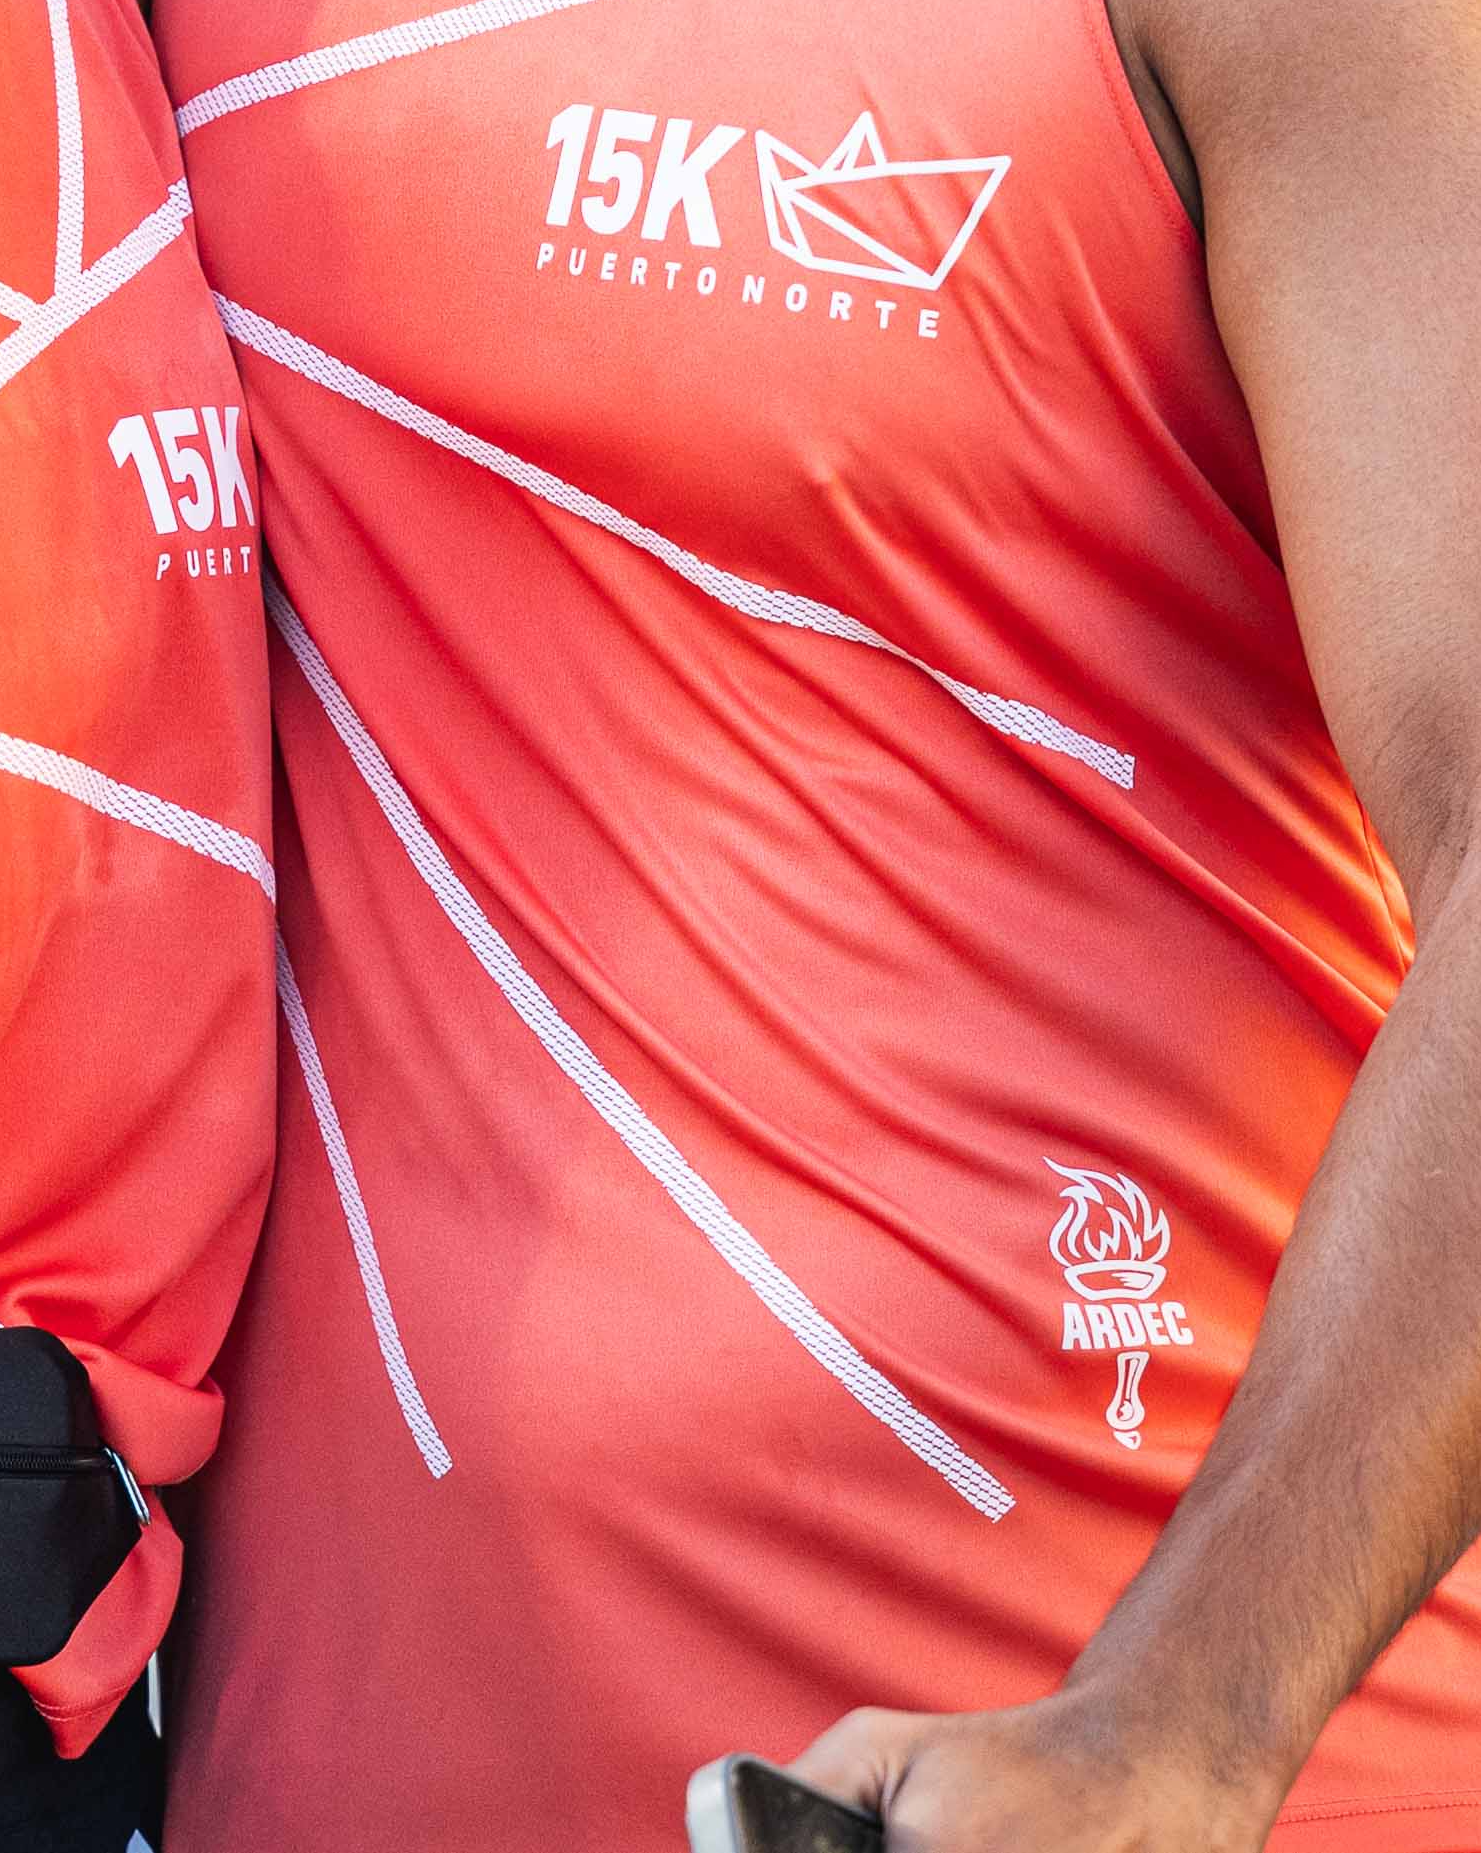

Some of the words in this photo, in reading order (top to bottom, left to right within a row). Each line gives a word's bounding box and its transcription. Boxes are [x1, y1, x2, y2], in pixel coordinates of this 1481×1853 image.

[545, 103, 747, 249] 15K
[106, 405, 257, 536] 15K
[155, 545, 252, 582] PUERT
[1061, 1301, 1195, 1351] ARDEC
